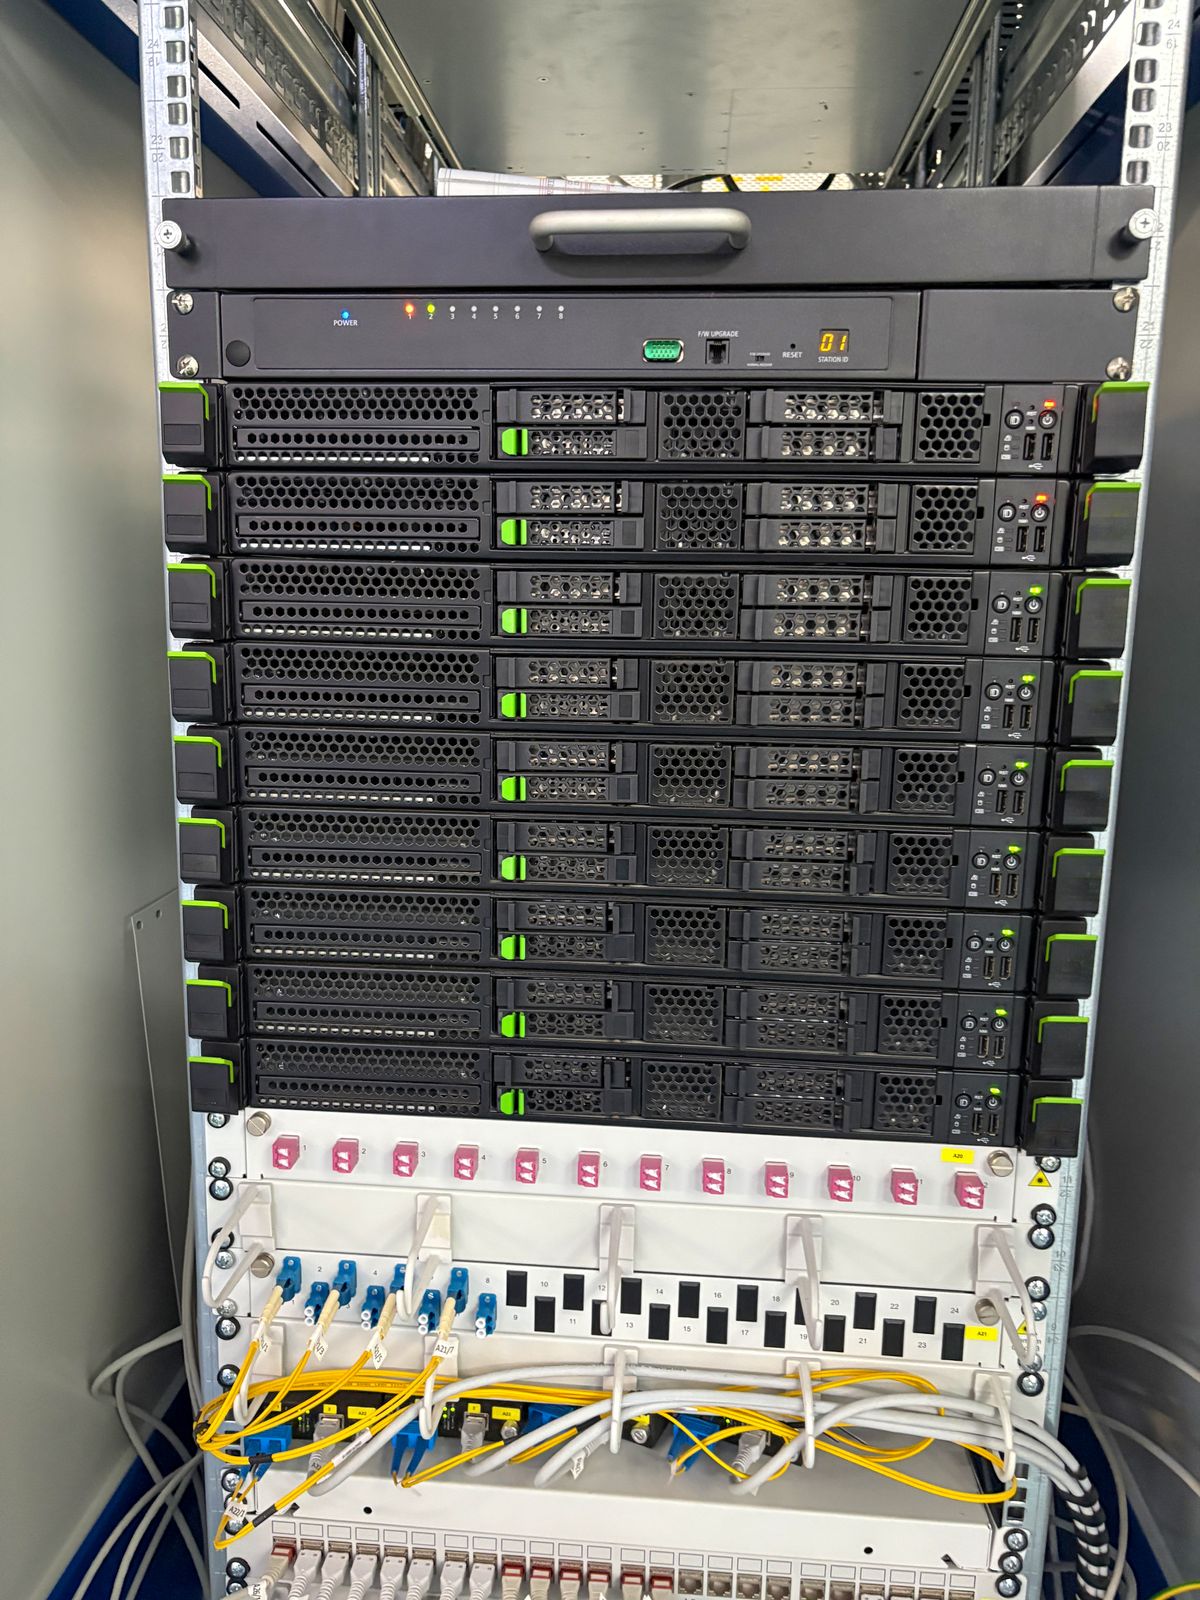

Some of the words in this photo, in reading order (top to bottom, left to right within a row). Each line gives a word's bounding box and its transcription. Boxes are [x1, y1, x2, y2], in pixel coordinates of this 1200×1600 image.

[1168, 20, 1180, 30] 24
[148, 38, 160, 50] 24
[152, 134, 162, 144] 23
[819, 333, 847, 352] 01
[540, 1280, 549, 1288] 10
[435, 1344, 454, 1355] A21/7
